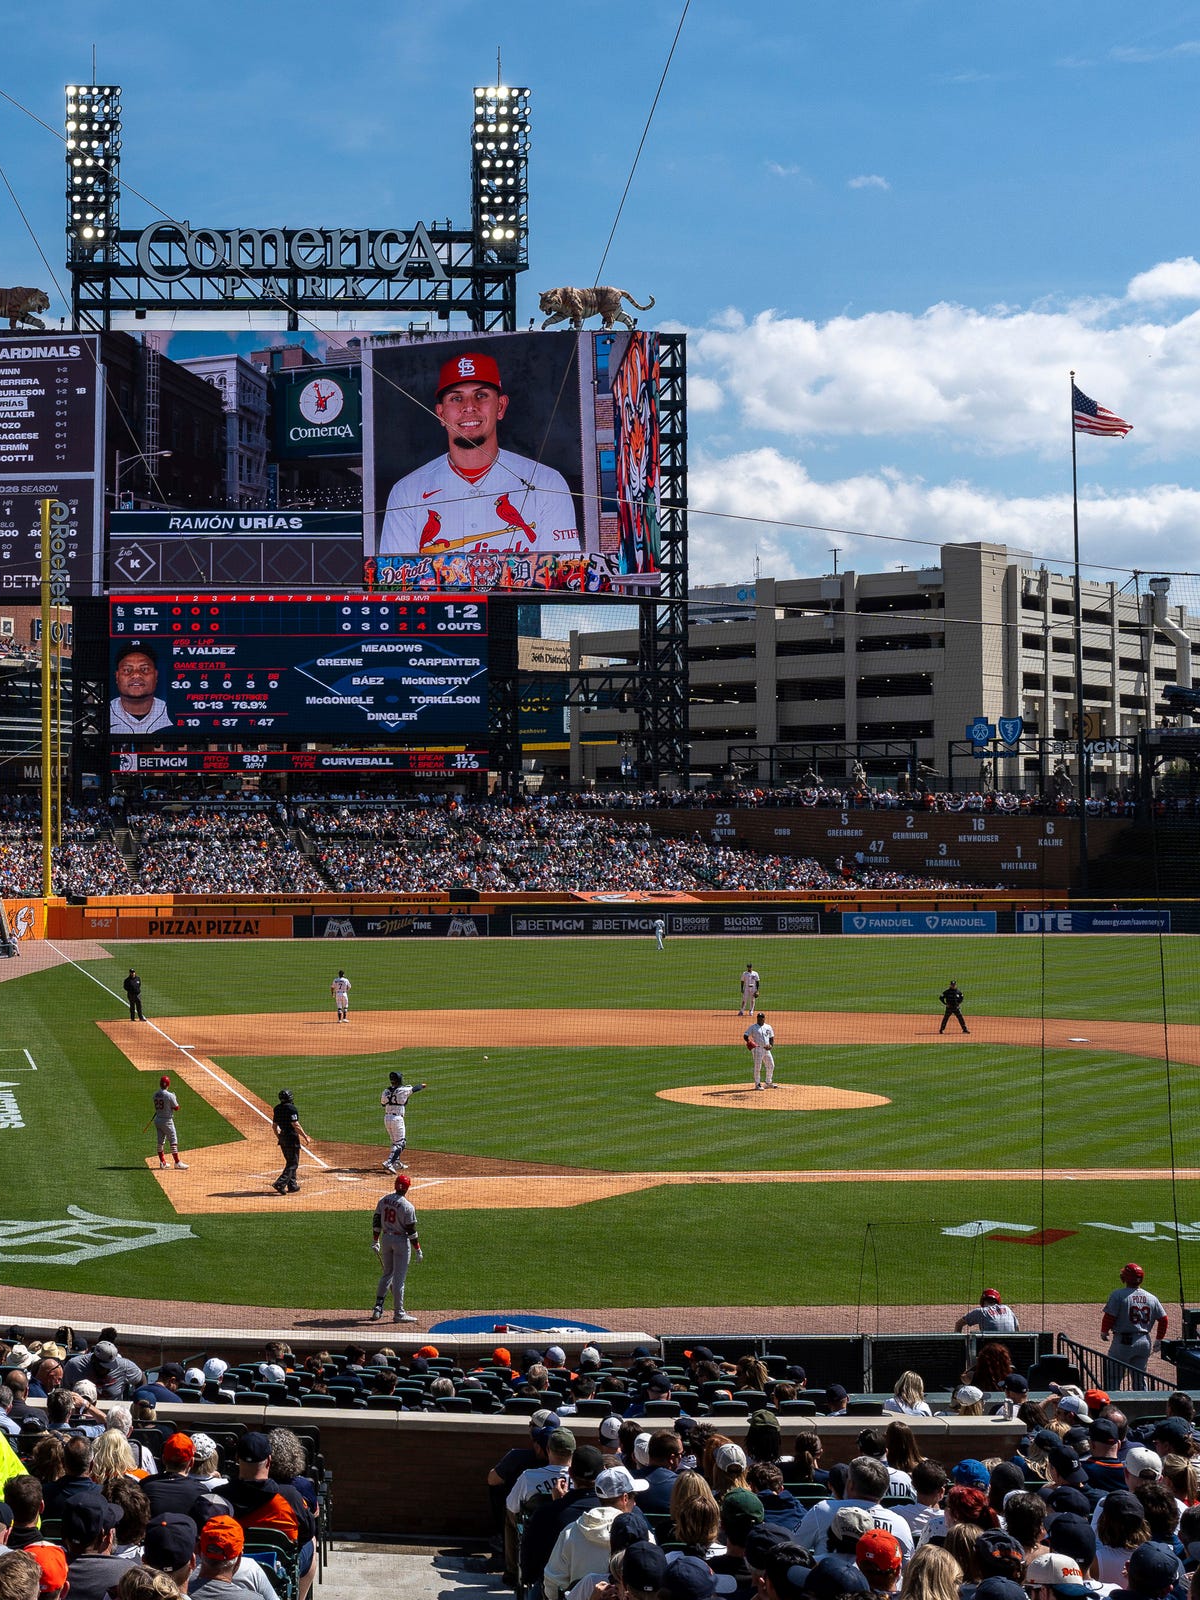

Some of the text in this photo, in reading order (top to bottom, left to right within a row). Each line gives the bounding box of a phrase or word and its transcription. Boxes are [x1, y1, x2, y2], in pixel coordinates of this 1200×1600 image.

[225, 276, 367, 298] PARK
[169, 515, 303, 529] RAMÓN URÍAS
[130, 559, 141, 568] K
[342, 607, 351, 615] 0
[361, 607, 370, 615] 3
[380, 607, 389, 615] 0
[400, 607, 407, 615] 2
[417, 607, 426, 615] 4
[445, 605, 478, 618] 1-2
[134, 623, 158, 631] DET
[172, 623, 181, 631] 0
[191, 623, 200, 631] 0
[210, 623, 219, 631] 0
[352, 676, 384, 685] BÁEZ
[402, 677, 470, 685] McKINSTRY
[409, 696, 480, 704] TORKELSON
[1053, 741, 1119, 753] BETMGM
[140, 758, 187, 767] BETMGM
[322, 758, 393, 766] CURVEBALL
[716, 814, 730, 824] 23
[841, 814, 848, 824] 5
[906, 816, 914, 828] 2
[972, 819, 985, 830] 16
[1046, 822, 1054, 834] 6
[869, 840, 884, 853] 47
[939, 844, 947, 855] 3
[1016, 847, 1022, 858] 1
[368, 922, 381, 930] IT'S
[377, 917, 418, 936] Miller
[528, 920, 584, 930] BETMGM
[869, 919, 913, 927] FANDUEL
[941, 918, 986, 926] FANDUEL
[1023, 914, 1072, 931] DTE
[149, 920, 259, 936] PIZZA! PIZZA!
[384, 1207, 396, 1223] 18
[1129, 1306, 1150, 1324] 63
